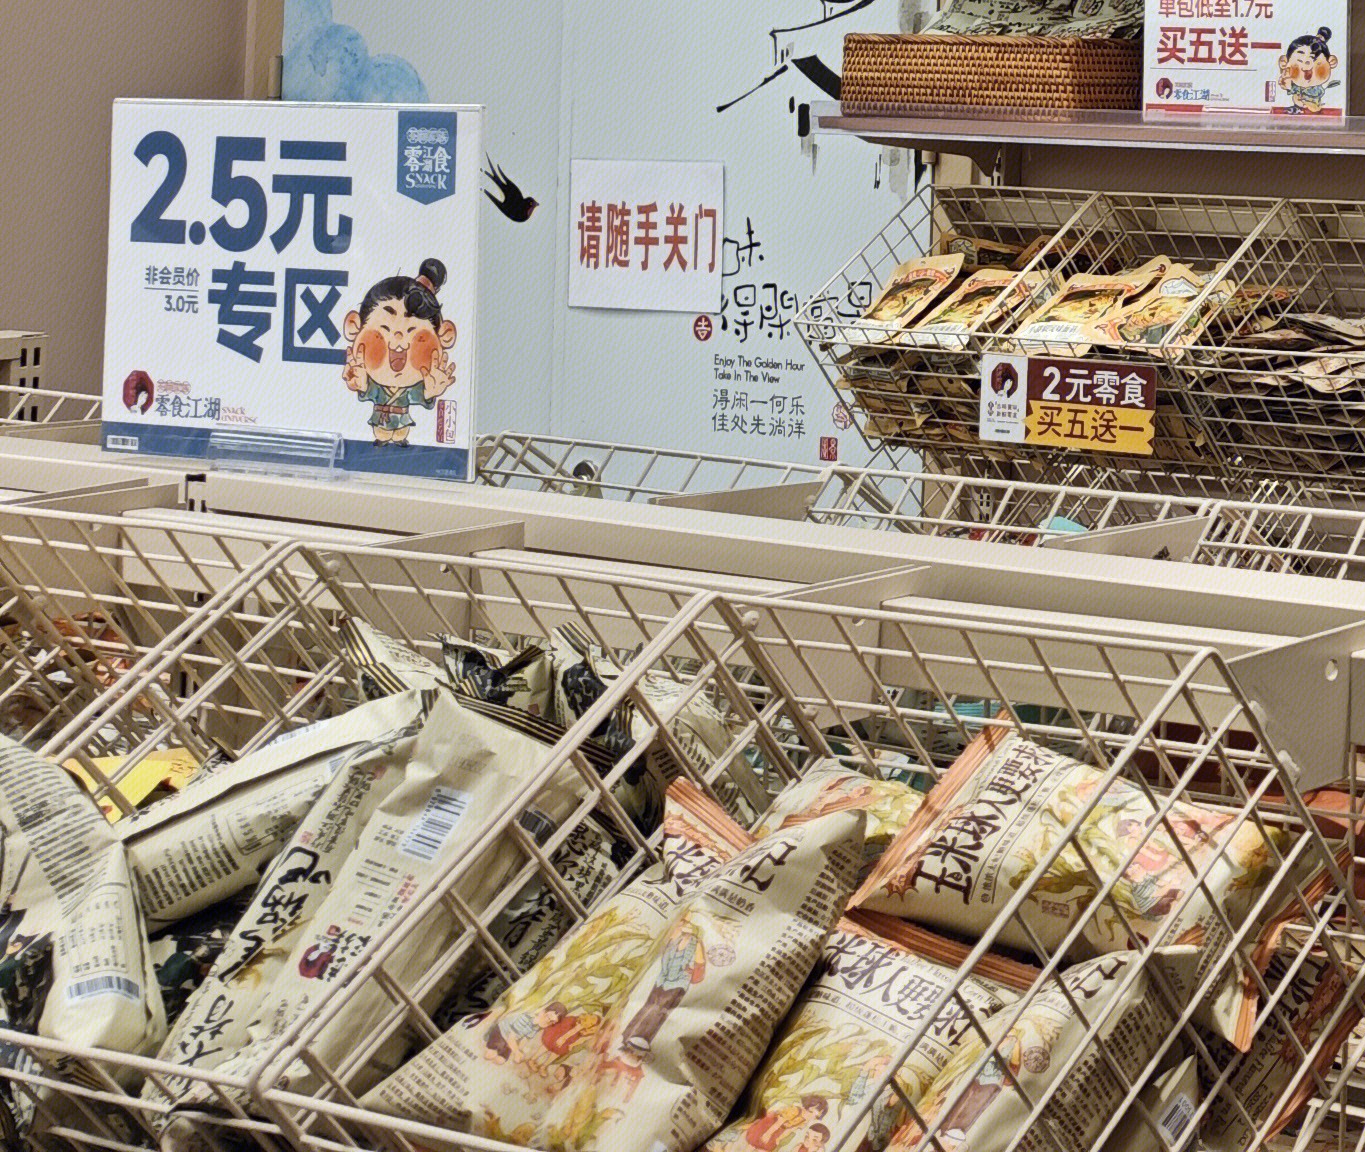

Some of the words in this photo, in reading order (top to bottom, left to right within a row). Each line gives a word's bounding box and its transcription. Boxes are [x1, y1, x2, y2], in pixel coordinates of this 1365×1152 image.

[1157, 26, 1281, 66] 买五送一
[130, 130, 353, 254] 2.5元
[577, 200, 717, 274] 请随手关门
[145, 265, 200, 287] 非会员价
[164, 294, 199, 314] 3.0元
[208, 260, 349, 366] 专区
[714, 354, 735, 369] Enjoy
[738, 355, 752, 368] The
[754, 356, 782, 370] Golden
[734, 369, 742, 381] In
[745, 370, 759, 383] The
[761, 371, 780, 384] View
[712, 388, 805, 416] 得闲一何乐
[1042, 366, 1147, 408] 2元零食
[1036, 405, 1144, 444] 买五送一
